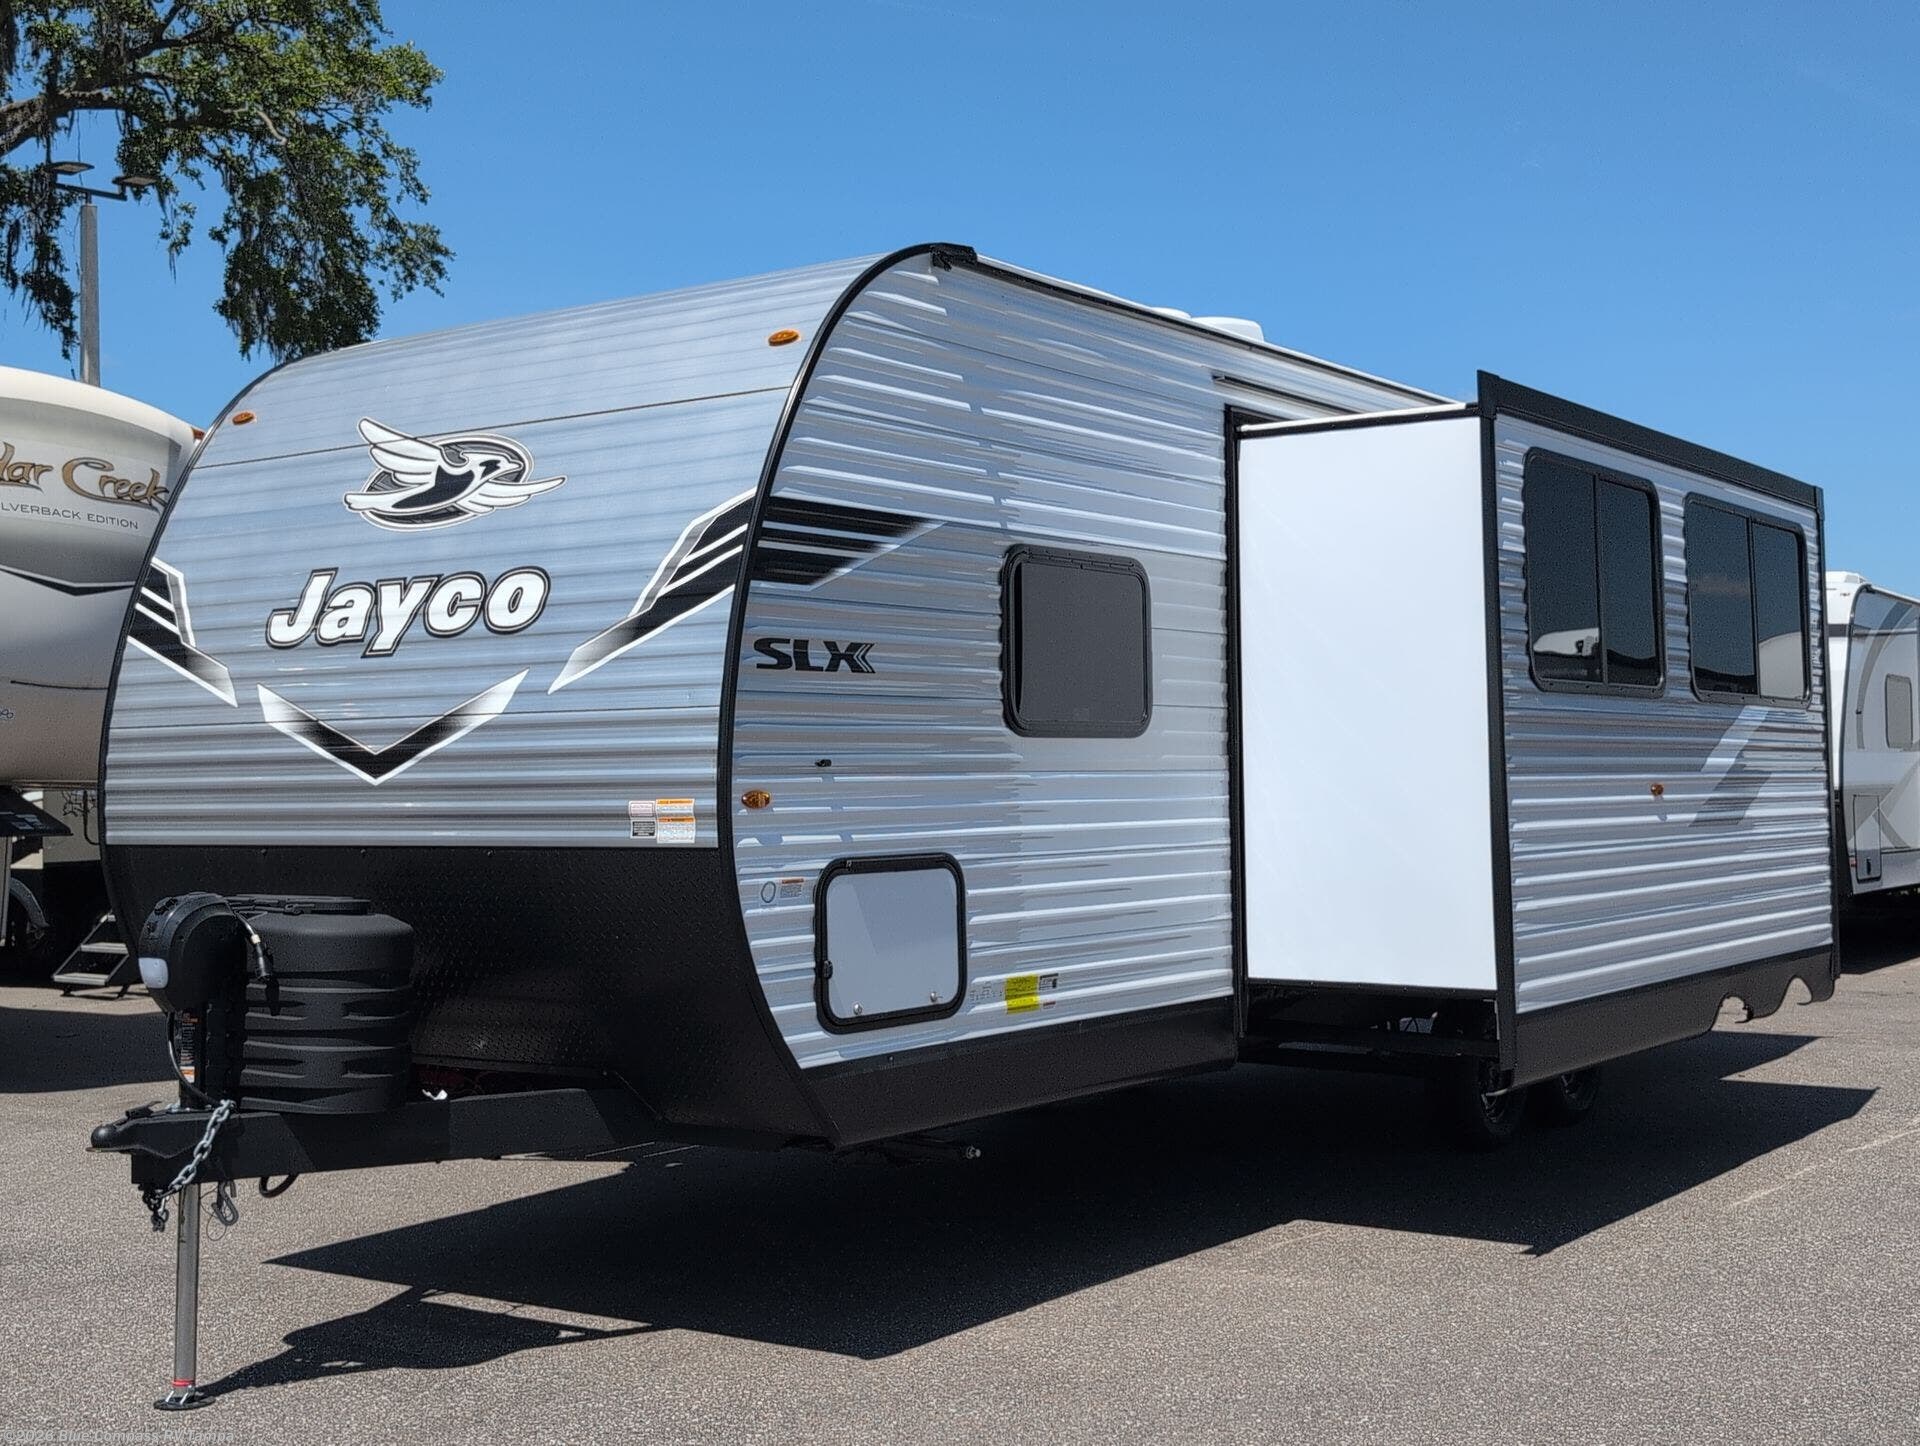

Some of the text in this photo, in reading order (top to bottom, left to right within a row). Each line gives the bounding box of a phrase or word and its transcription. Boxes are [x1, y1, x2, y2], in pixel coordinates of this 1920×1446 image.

[62, 457, 169, 511] Creek
[1, 503, 139, 530] LVERBACK EDITION
[265, 566, 552, 658] Jayco
[753, 637, 876, 674] SLX
